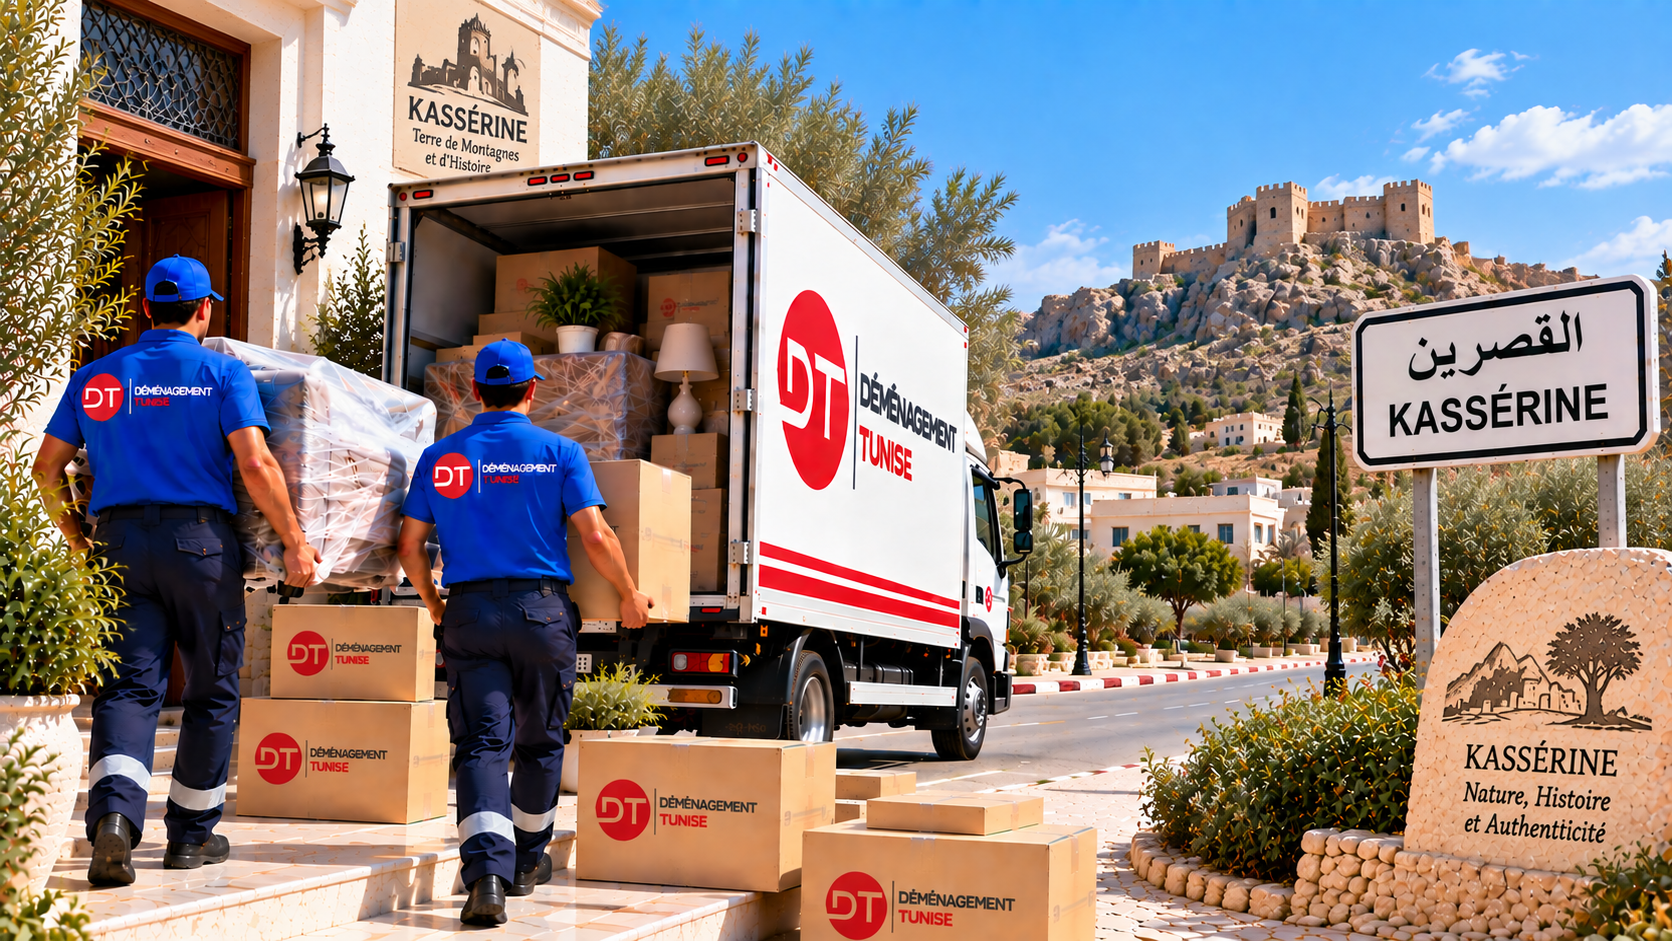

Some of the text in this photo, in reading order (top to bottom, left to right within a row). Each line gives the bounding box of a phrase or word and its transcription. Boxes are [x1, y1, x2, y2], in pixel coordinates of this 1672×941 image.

[408, 96, 528, 143] KASSÉRINE
[412, 127, 520, 162] Terre de Montagnes
[425, 153, 491, 173] et d'Histoire
[1408, 309, 1583, 381] القصرين
[83, 387, 121, 408] DT
[780, 336, 847, 441] DT
[860, 372, 957, 453] DÉMÉNAGEMENT
[1389, 383, 1609, 438] KASSÉRINE
[859, 424, 912, 482] TUNISE
[434, 466, 471, 487] DT
[289, 643, 326, 665] DT
[335, 655, 370, 665] TUNISE
[256, 746, 298, 770] DT
[310, 746, 388, 760] DÉMÉNAGEMENT
[1464, 739, 1618, 777] KASSÉRINE
[310, 761, 349, 773] TUNISE
[659, 795, 757, 813] DÉMÉNAGEMENT
[1463, 781, 1611, 811] Nature, Histoire
[597, 796, 647, 825] DT
[659, 813, 708, 828] TUNISE
[1464, 814, 1481, 833] et
[827, 889, 883, 923] DT
[898, 889, 1016, 911] DÉMÉNAGEMENT
[898, 909, 953, 927] TUNISE
